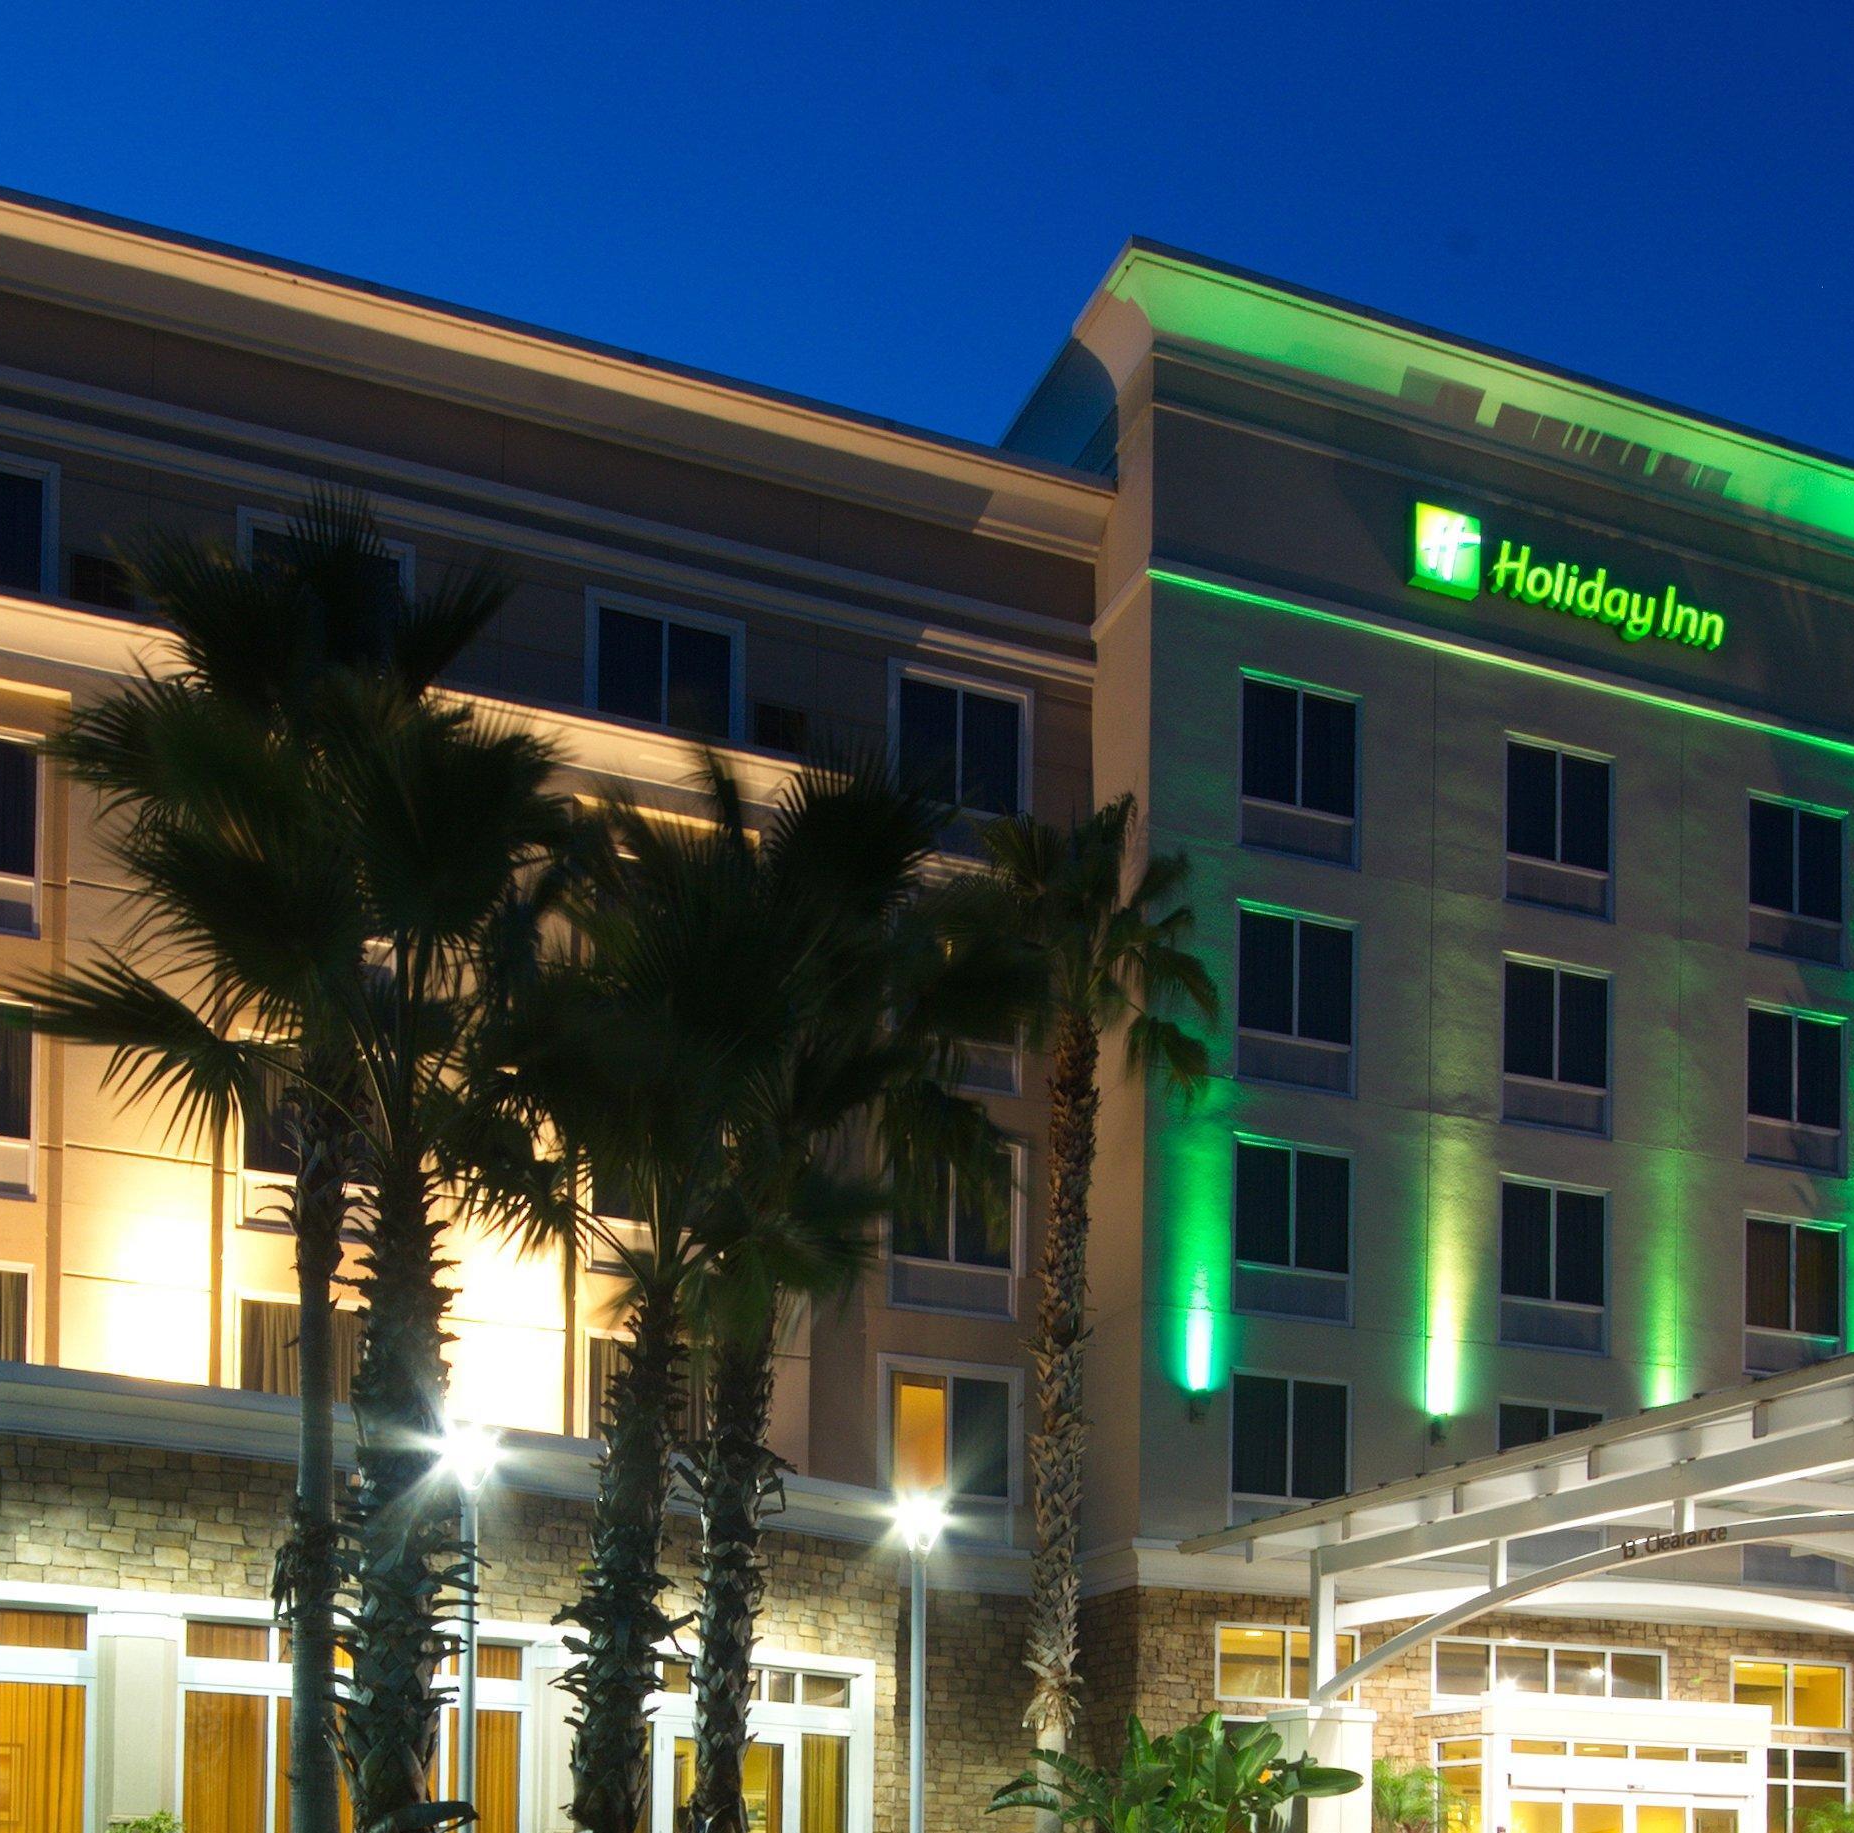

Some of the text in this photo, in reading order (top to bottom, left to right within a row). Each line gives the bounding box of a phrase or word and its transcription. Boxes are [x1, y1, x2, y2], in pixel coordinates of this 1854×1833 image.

[1490, 540, 1725, 650] Holiday Inn
[1645, 1526, 1728, 1553] Clearance
